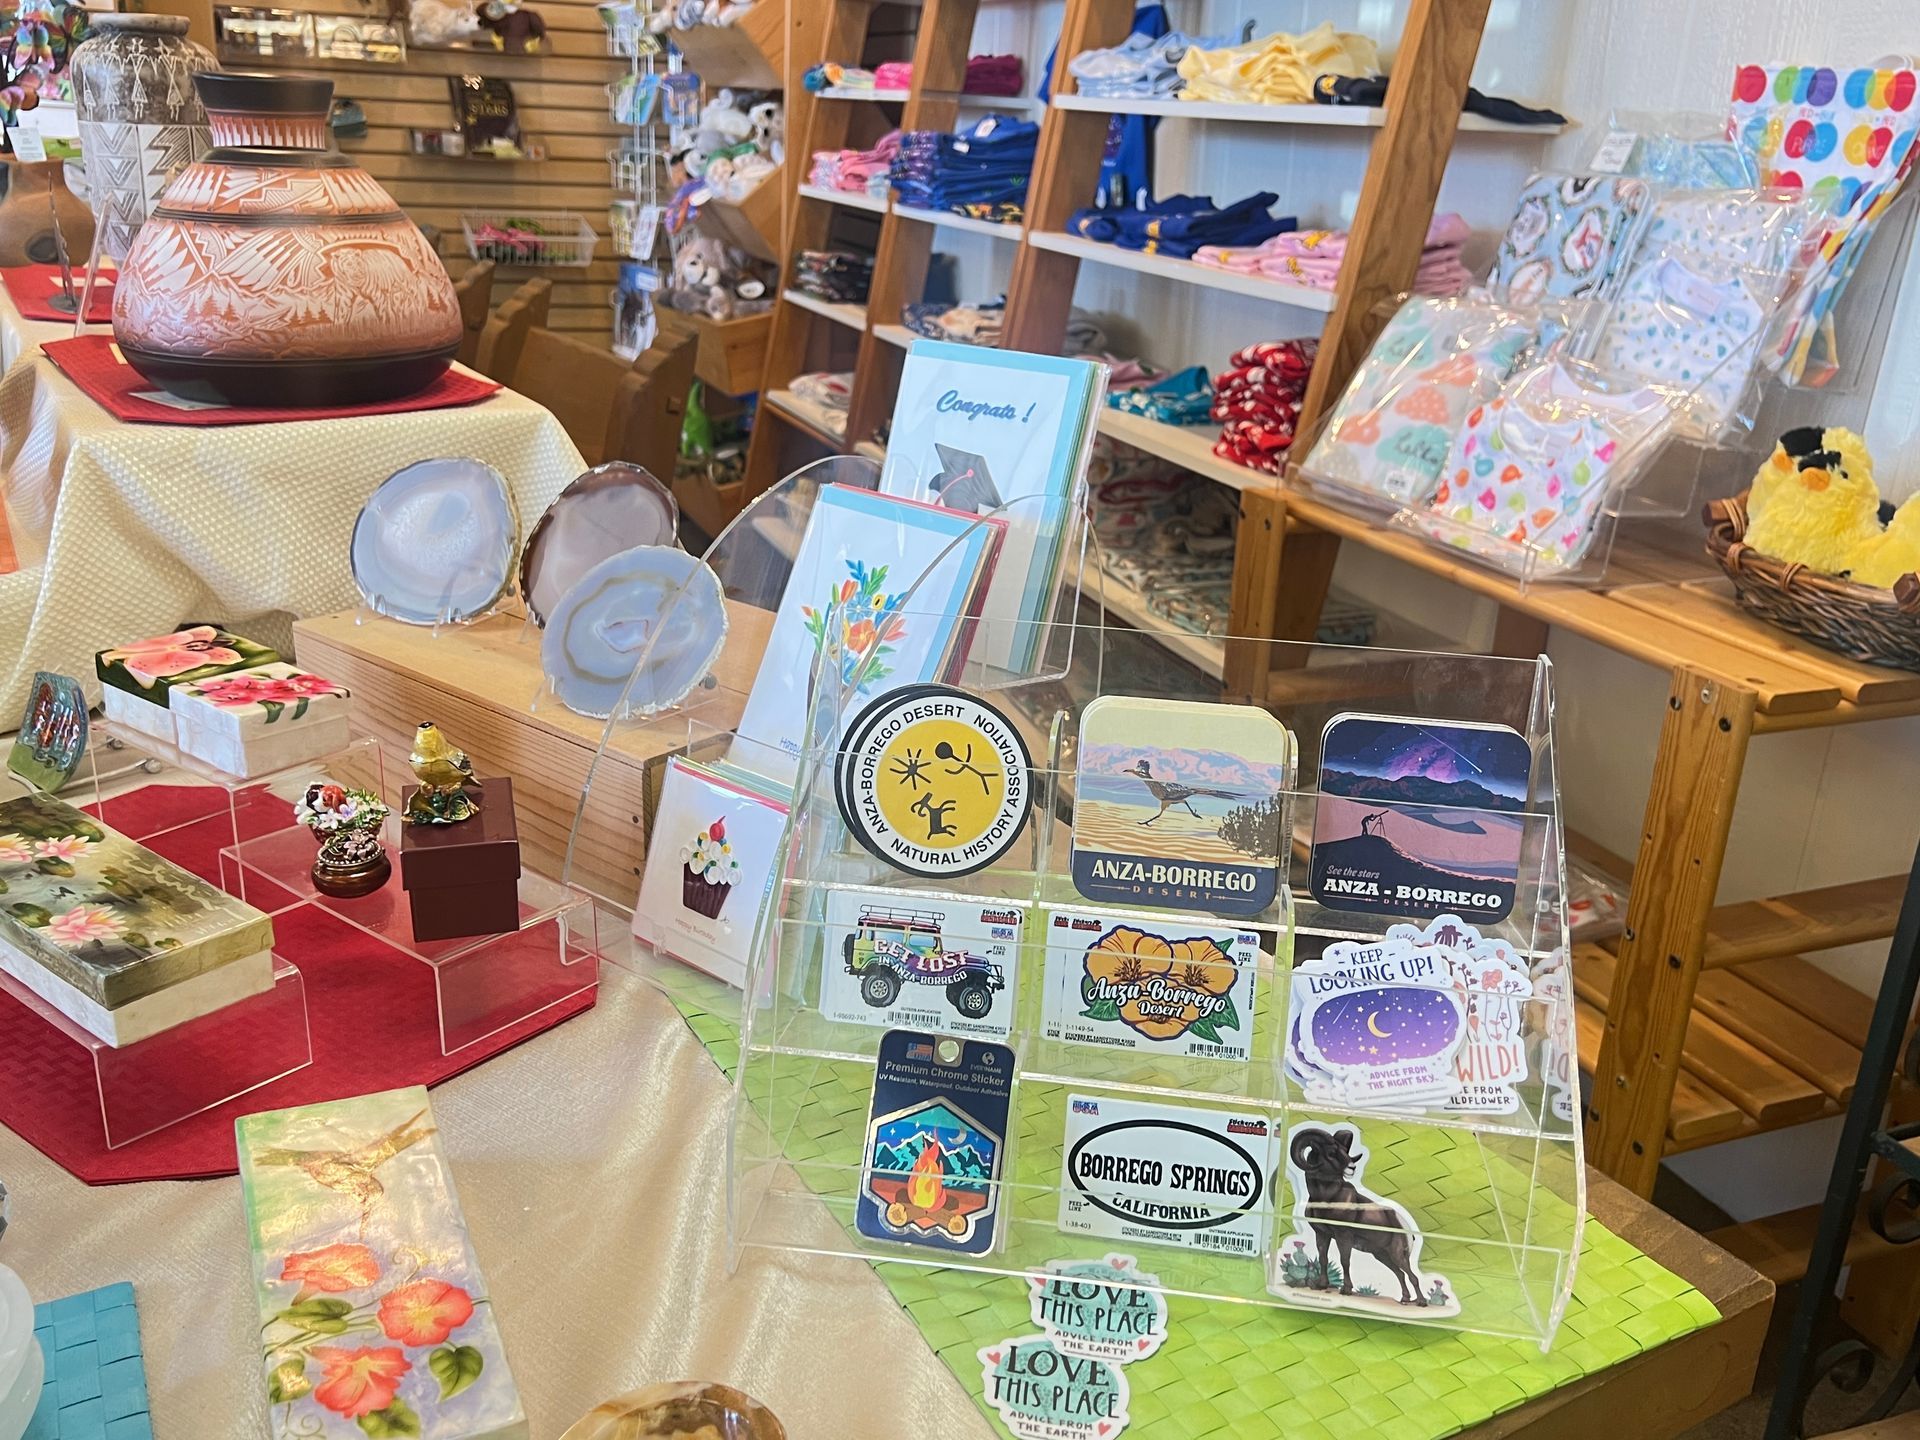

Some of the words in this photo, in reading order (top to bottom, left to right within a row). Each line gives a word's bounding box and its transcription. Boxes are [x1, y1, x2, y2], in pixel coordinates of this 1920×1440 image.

[861, 719, 901, 834] ANZA-BORREGO
[903, 704, 965, 724] DESERT
[973, 714, 1020, 808] ASSOCIATION
[963, 810, 1014, 860] HISTORY
[891, 838, 961, 865] NATURAL
[1091, 859, 1256, 892] ANZA-BORREGO
[1326, 864, 1342, 875] See
[1343, 867, 1358, 878] the
[1359, 870, 1381, 879] stars
[1132, 885, 1212, 900] DESERT
[1323, 878, 1379, 896] ANZA
[1396, 885, 1502, 908] BORREGO
[1383, 899, 1440, 909] DESERT
[874, 939, 914, 963] GET
[916, 950, 968, 972] LOST
[1351, 948, 1384, 965] KEEP
[878, 956, 890, 966] IN
[891, 963, 968, 985] ANZA-BORREGO
[1309, 963, 1395, 994] LOOKING
[1400, 955, 1435, 981] UP!
[1087, 976, 1226, 1014] Anza-Borrego
[1138, 1001, 1184, 1018] Desert
[885, 1061, 928, 1076] Premium
[931, 1067, 969, 1081] Chrome
[971, 1073, 1005, 1087] Sticker
[1369, 1068, 1401, 1080] ADVICE
[1402, 1065, 1428, 1076] FROM
[1455, 1044, 1520, 1082] WILD!
[980, 1087, 1009, 1097] Adhesive
[1367, 1080, 1385, 1090] THE
[1387, 1077, 1413, 1088] NIGHT
[1474, 1086, 1503, 1095] FROM
[1079, 1152, 1163, 1187] BORREGO
[1170, 1163, 1251, 1197] SPRINGS
[1112, 1192, 1211, 1220] CALIFORNIA
[1052, 1269, 1149, 1308] LOVE
[1038, 1296, 1084, 1327] THIS
[1094, 1307, 1158, 1336] PLACE
[1055, 1330, 1096, 1342] ADVICE
[1101, 1336, 1133, 1347] FROM
[1061, 1340, 1084, 1349] THE
[1007, 1345, 1109, 1387] LOVE
[992, 1375, 1041, 1408] THIS
[1053, 1386, 1120, 1418] PLACE
[1009, 1411, 1053, 1424] ADVICE
[1059, 1419, 1093, 1431] FROM
[1017, 1421, 1040, 1433] THE
